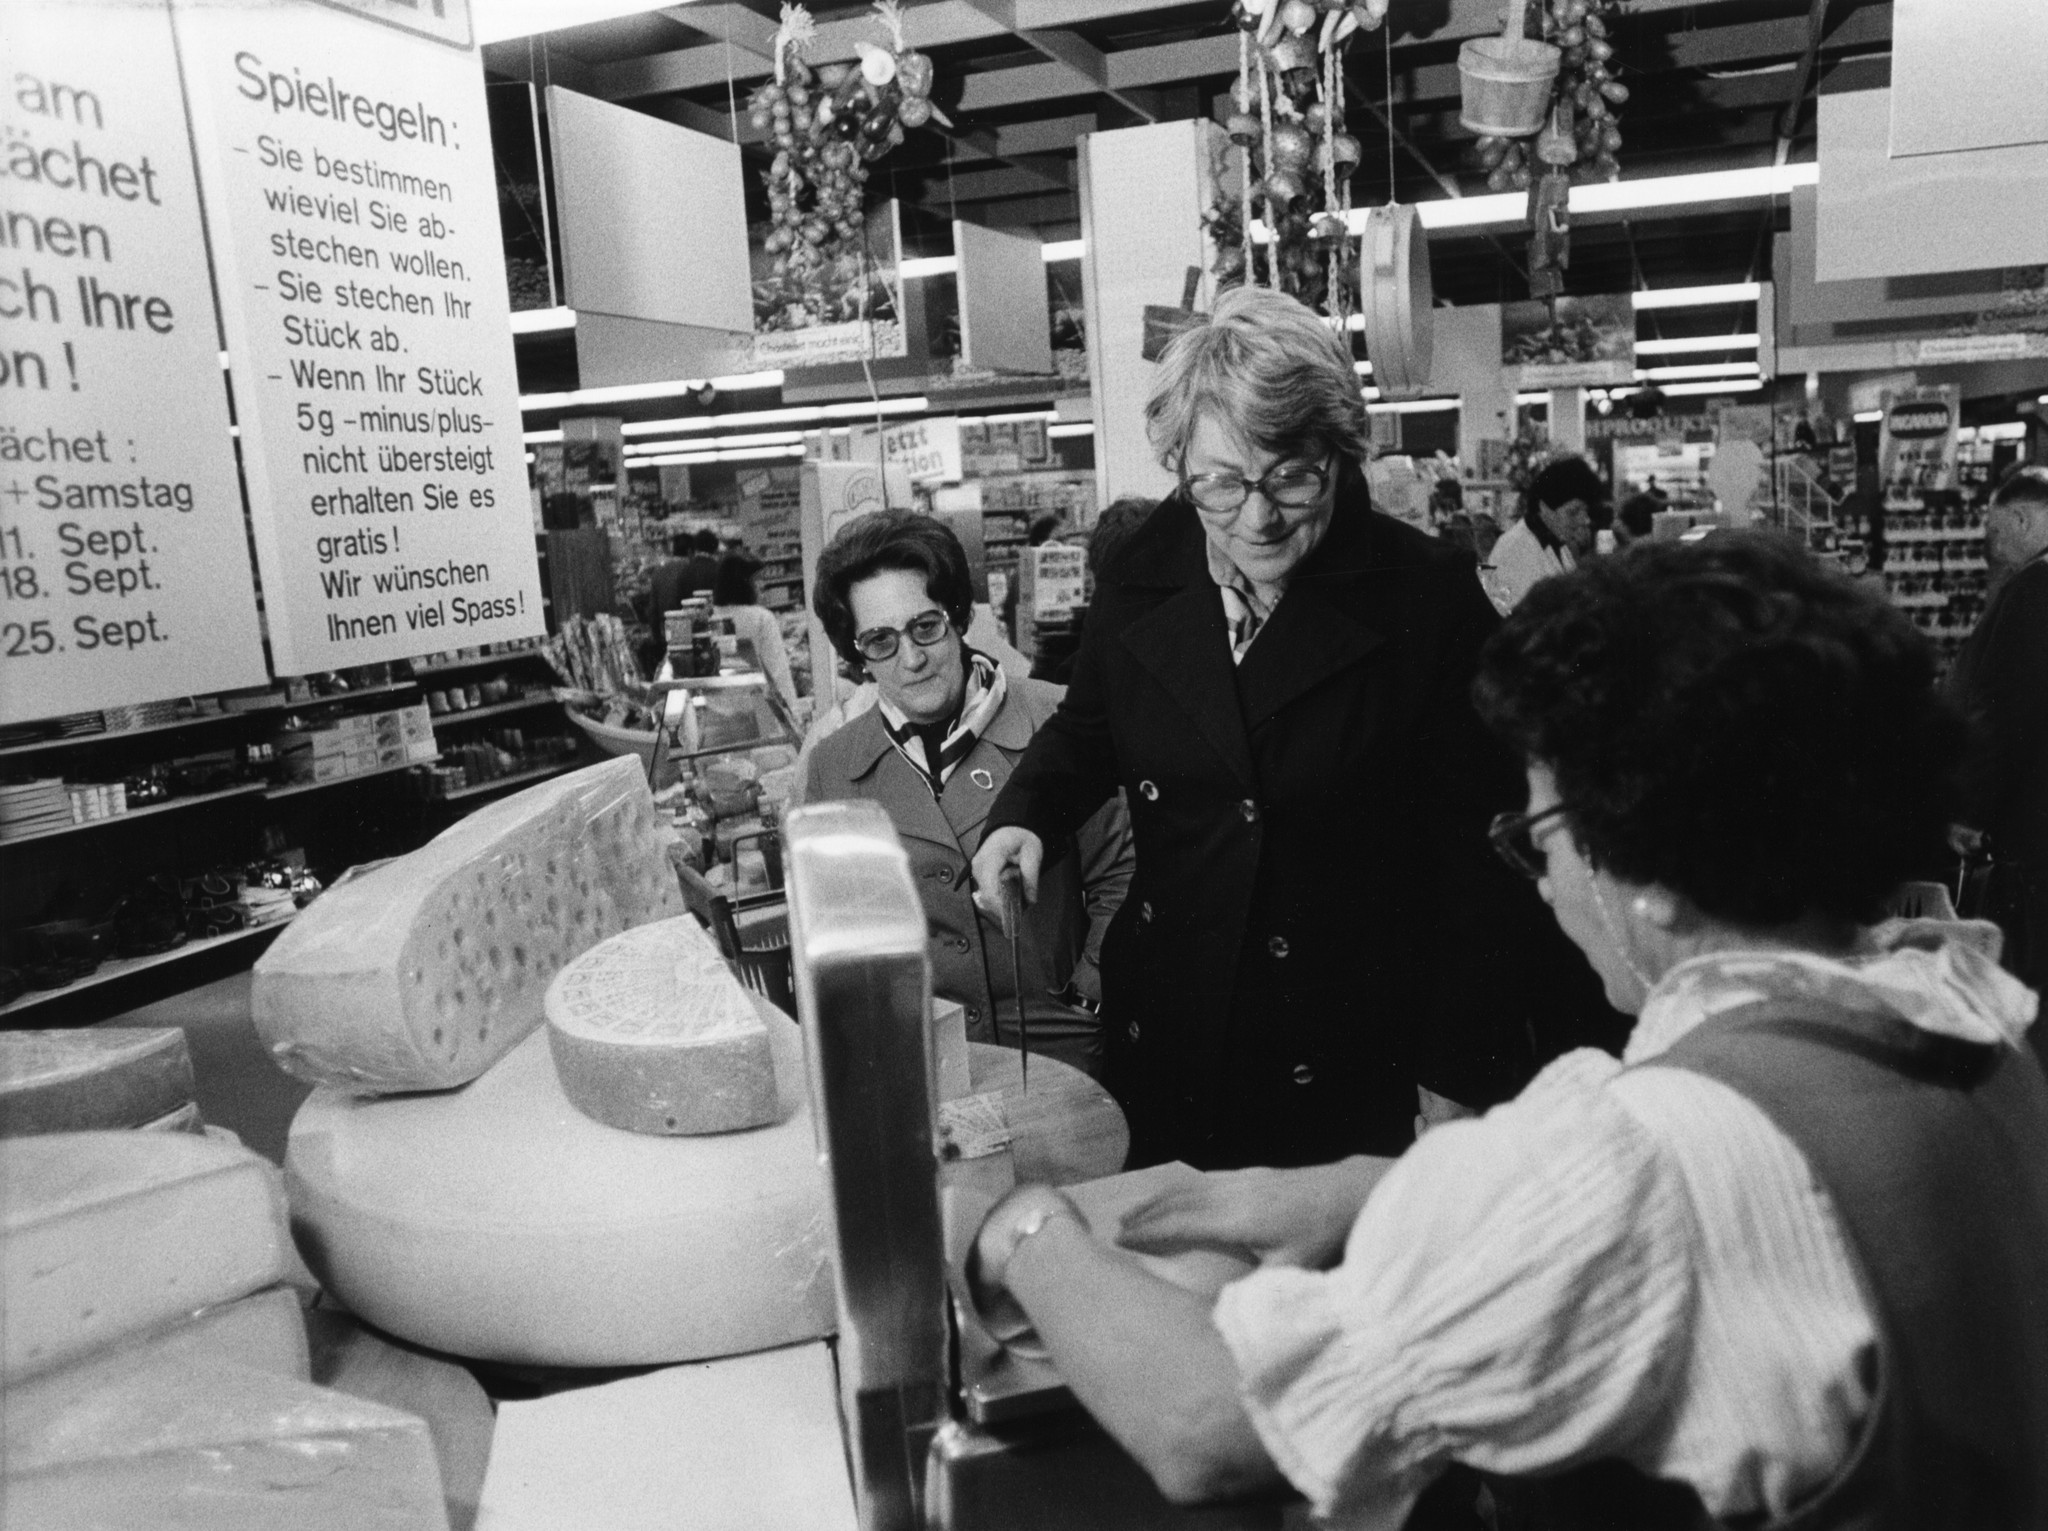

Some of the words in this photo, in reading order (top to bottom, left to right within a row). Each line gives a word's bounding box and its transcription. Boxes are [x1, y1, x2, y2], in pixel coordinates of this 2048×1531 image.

[16, 75, 103, 129] am
[234, 51, 461, 150] Spielregeln:
[257, 134, 303, 172] Sie
[314, 147, 453, 202] bestimmen
[263, 186, 360, 225] wieviel
[369, 200, 407, 234] Sie
[419, 213, 455, 240] ab-
[270, 229, 379, 269] stechen
[389, 250, 470, 281] wollen.
[77, 275, 174, 335] Ihre
[277, 269, 322, 304] Sie
[334, 280, 434, 315] stechen
[444, 291, 472, 319] Ihr
[283, 314, 362, 350] Stück
[370, 325, 408, 353] ab.
[289, 359, 366, 391] Wenn
[375, 364, 406, 393] Ihr
[417, 366, 483, 396] Stück
[302, 444, 369, 474] nicht
[378, 445, 495, 476] übersteigt
[887, 427, 928, 454] etzt
[310, 485, 414, 517] erhalten
[422, 483, 459, 512] Sie
[469, 488, 496, 509] es
[57, 521, 158, 561] Sept.
[0, 565, 50, 600] 18.
[64, 558, 161, 598] Sept.
[319, 569, 362, 600] Wir
[372, 559, 490, 594] wünschen
[1, 619, 65, 658] 25.
[73, 610, 169, 651] Sept.
[326, 613, 397, 642] Ihnen
[405, 600, 445, 630] viel
[451, 590, 525, 627] Spass!
